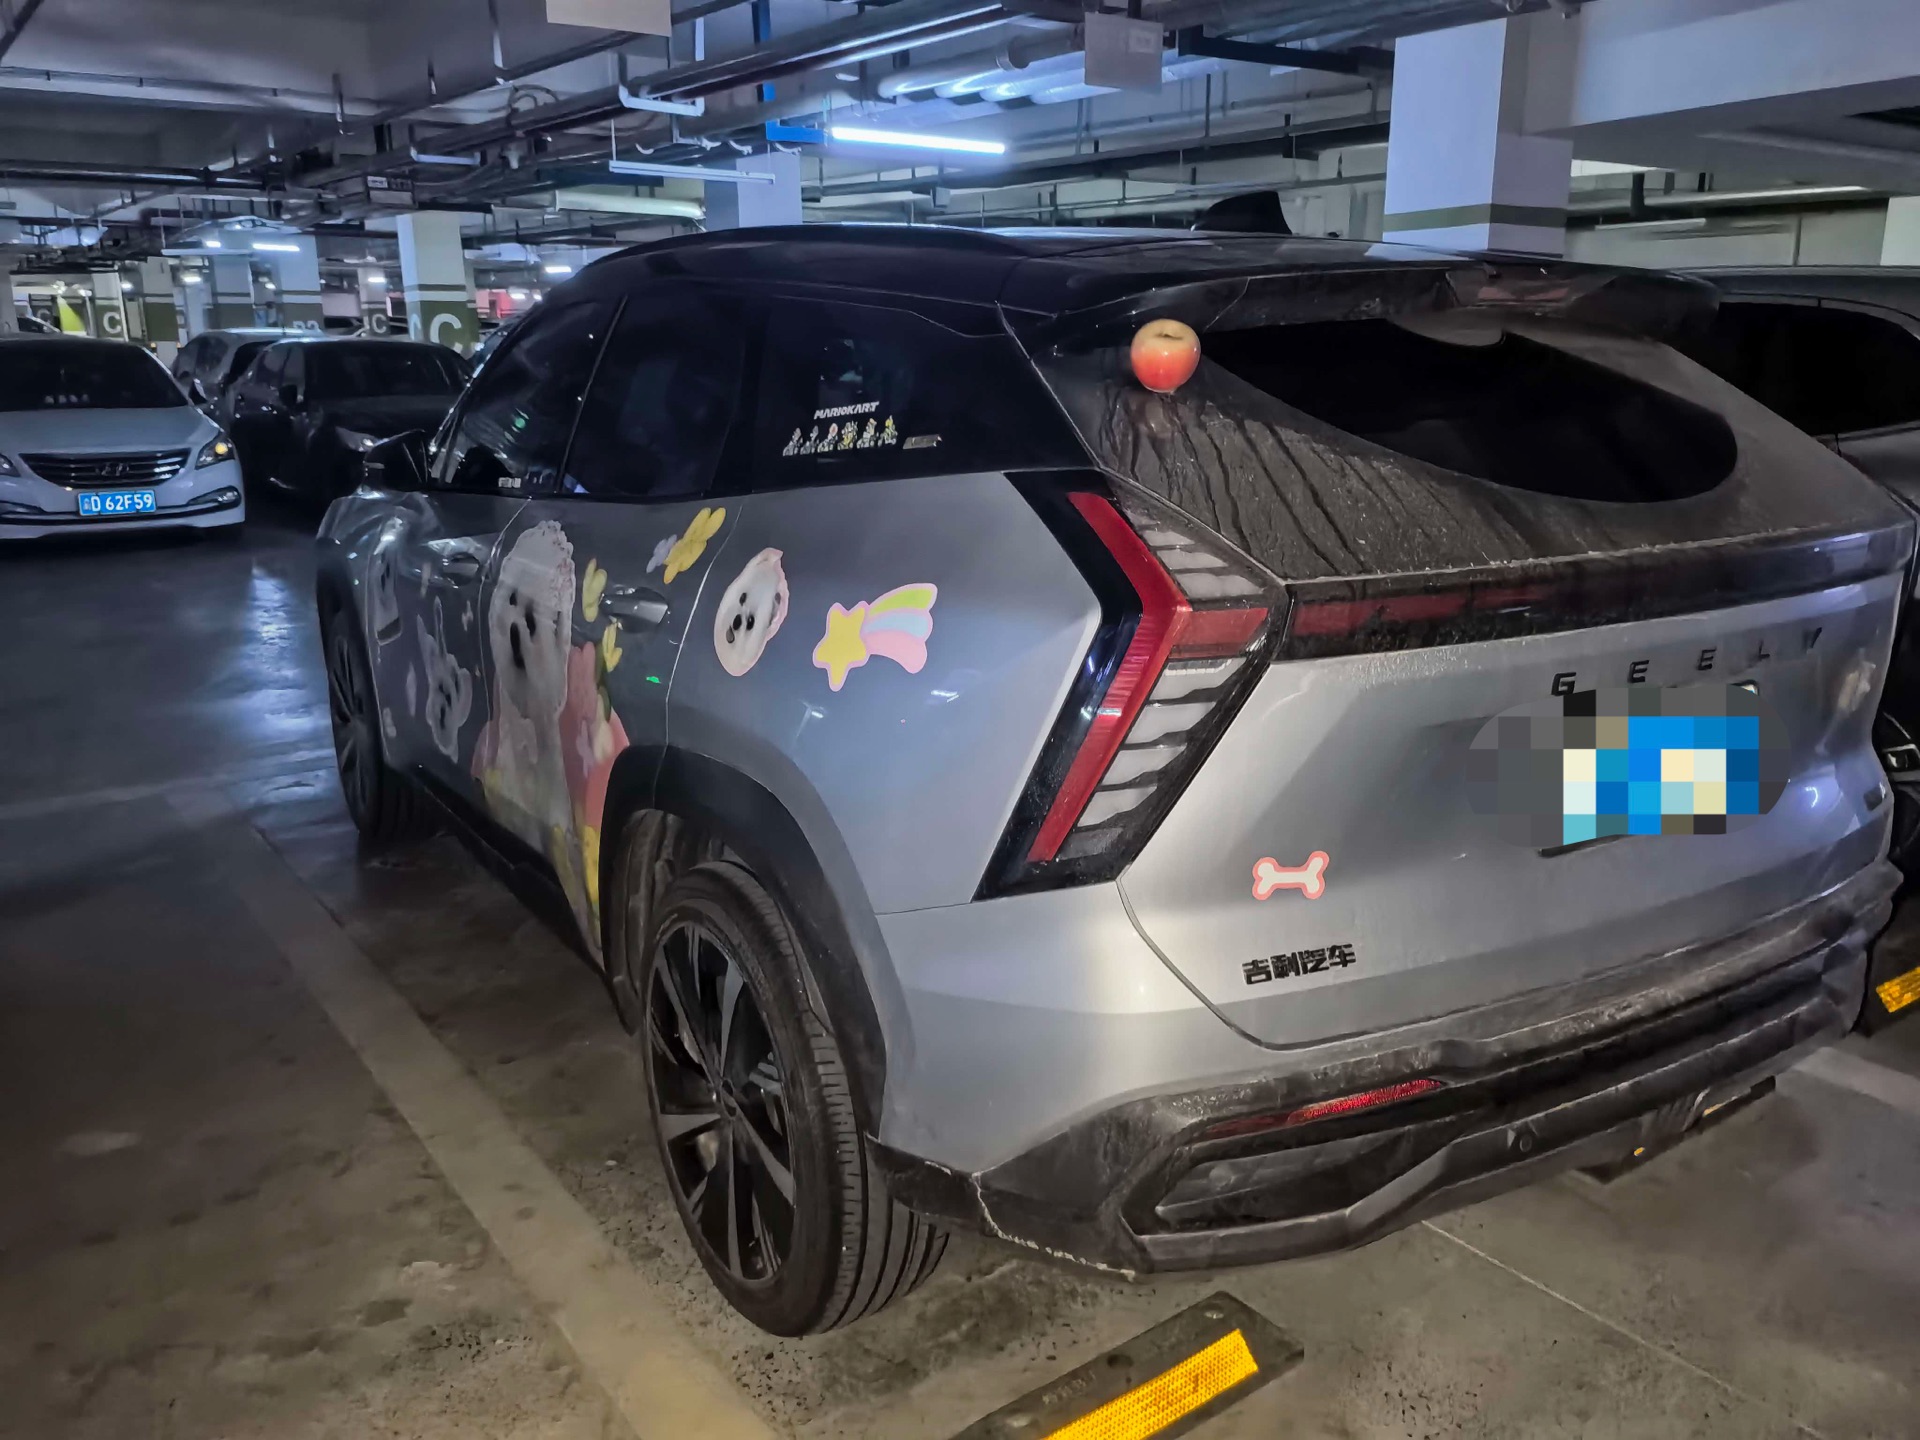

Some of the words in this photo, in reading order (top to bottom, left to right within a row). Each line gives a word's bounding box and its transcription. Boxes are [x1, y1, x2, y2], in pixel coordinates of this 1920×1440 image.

[102, 311, 122, 334] C
[371, 313, 387, 334] C
[429, 313, 463, 353] C
[1242, 943, 1357, 985] 吉利汽车
